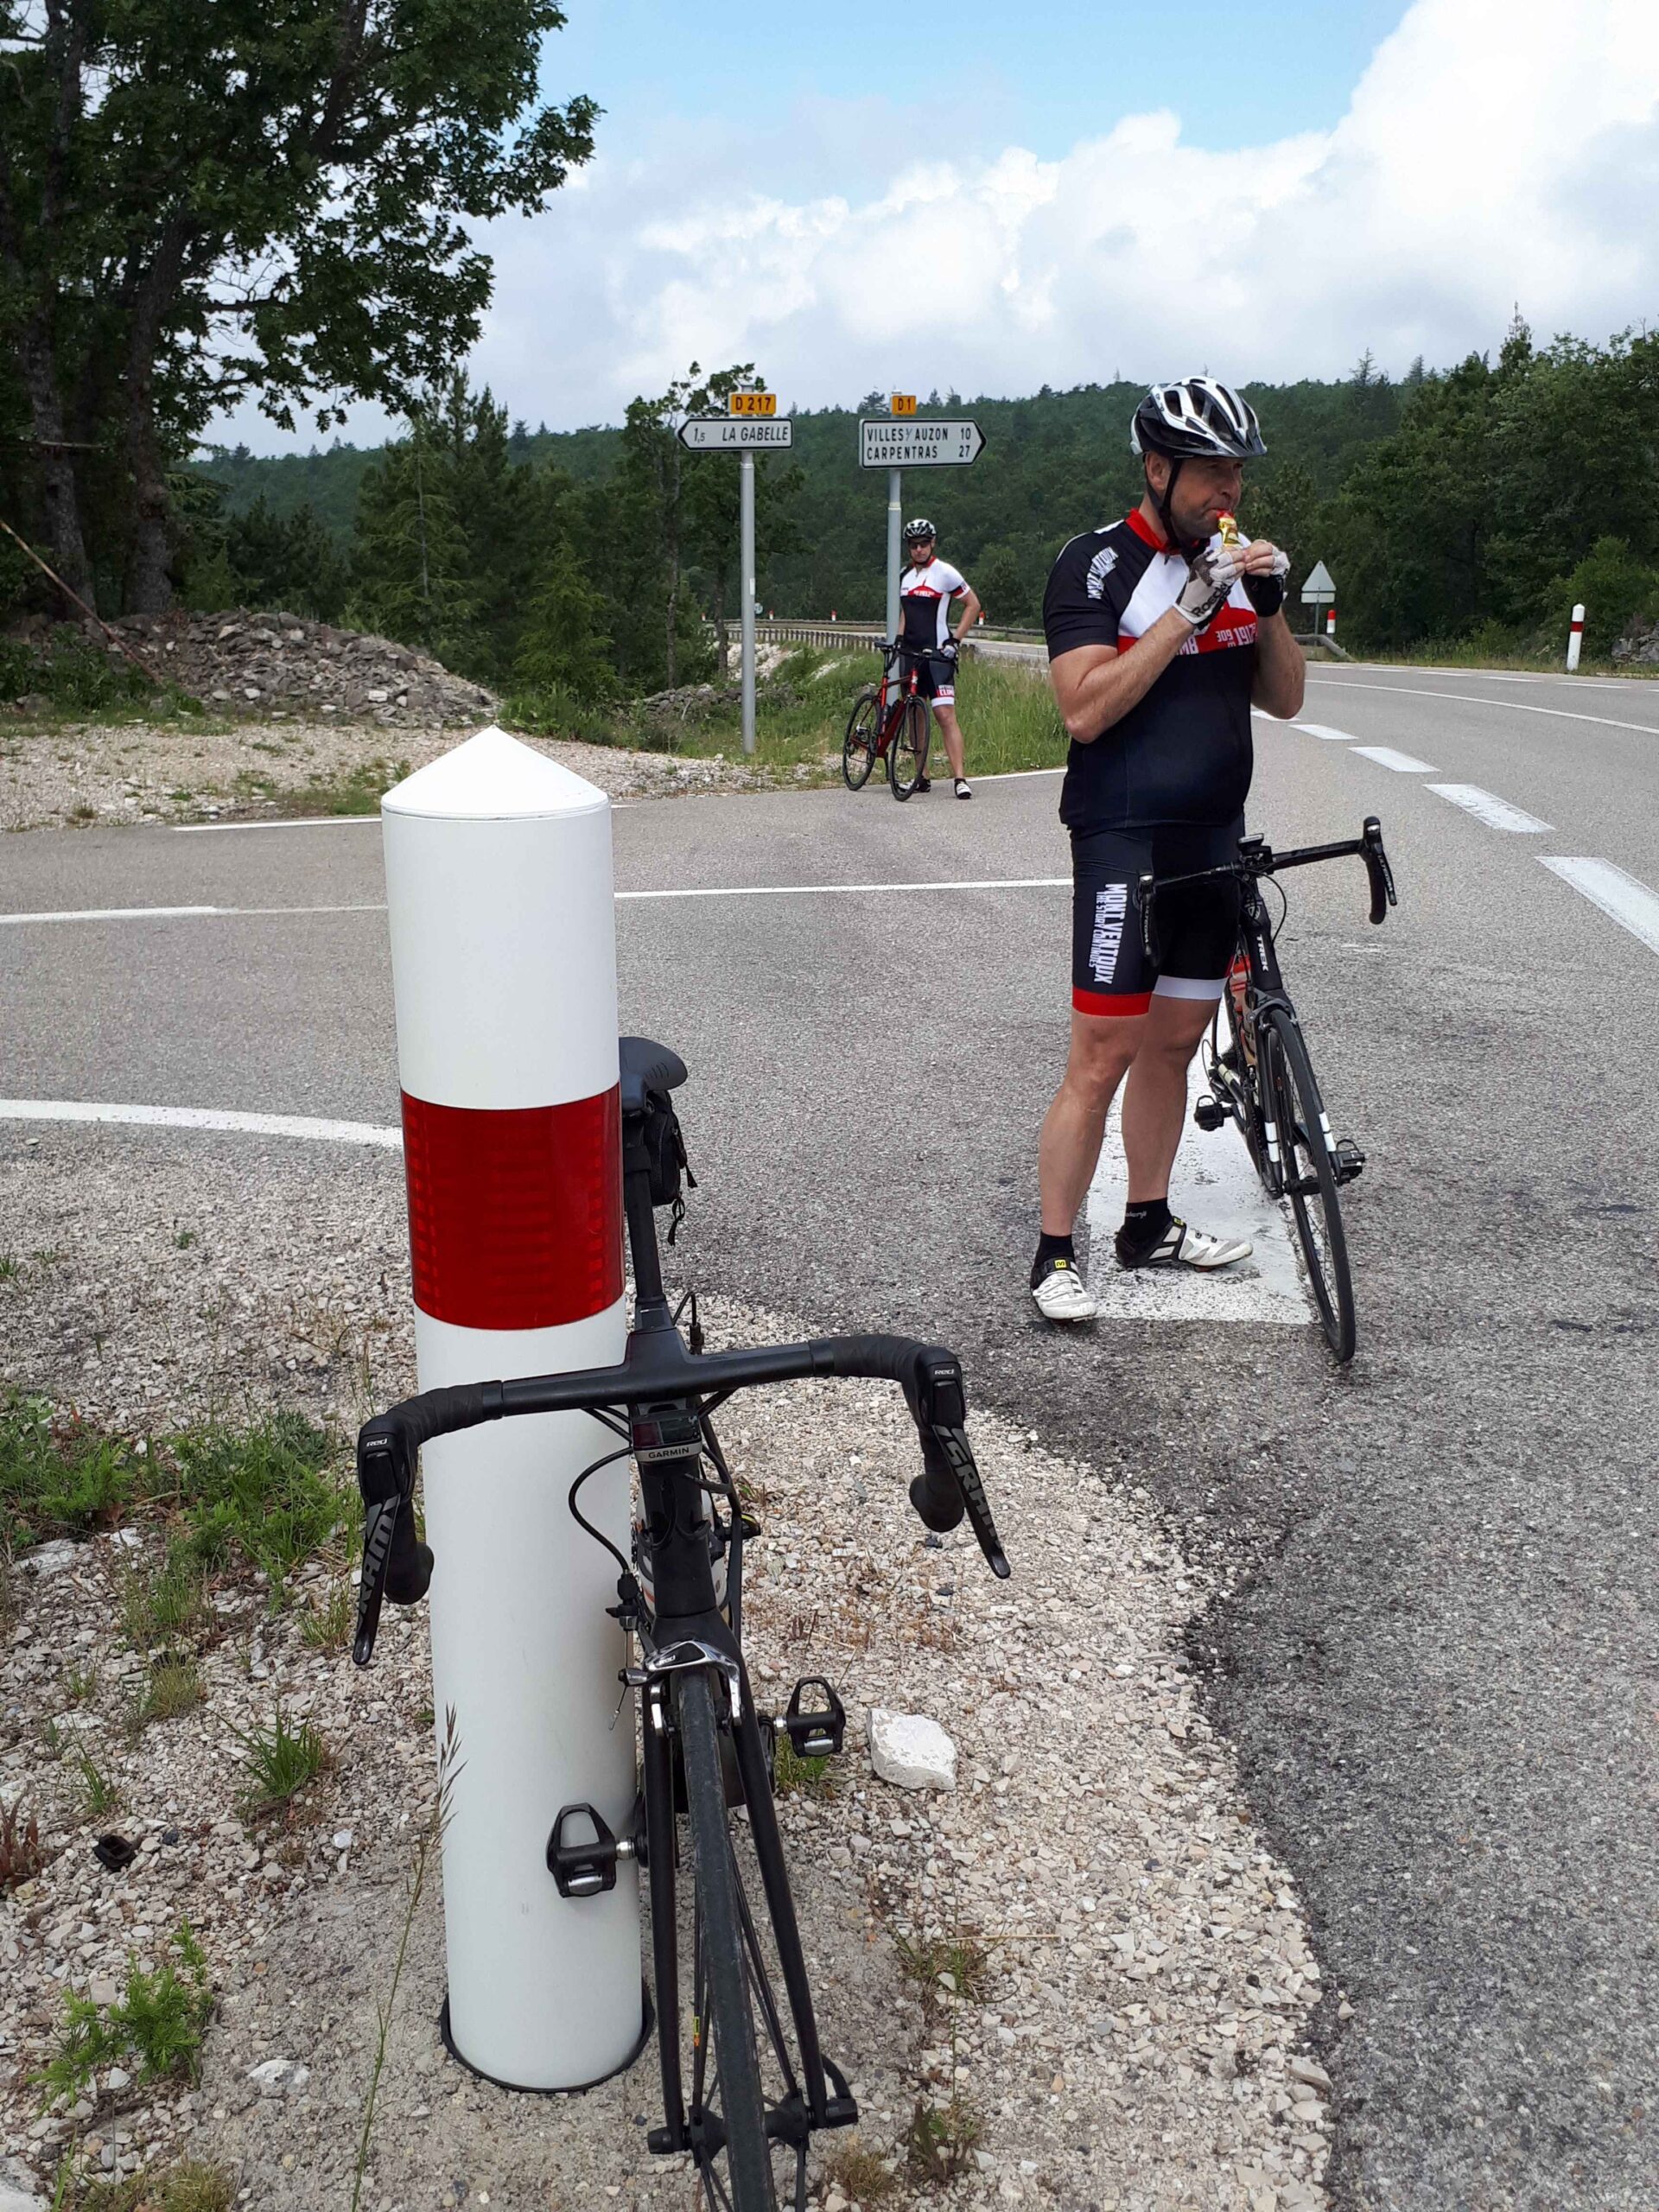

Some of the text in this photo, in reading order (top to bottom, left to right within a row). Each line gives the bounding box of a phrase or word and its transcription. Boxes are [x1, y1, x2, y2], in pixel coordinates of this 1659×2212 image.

[735, 397, 772, 411] D 217
[898, 398, 912, 411] D 1
[694, 427, 789, 443] 1,5 LA GABELLE
[867, 429, 904, 442] VILLES
[914, 428, 949, 442] AUZON
[960, 428, 971, 441] 10
[867, 445, 970, 461] CARPENTRAS 27
[1088, 891, 1107, 968] THE STORY CONTINUES
[1093, 883, 1128, 984] MONT VENTOUX
[1255, 934, 1269, 972] TREK
[648, 1446, 690, 1459] GARMIN
